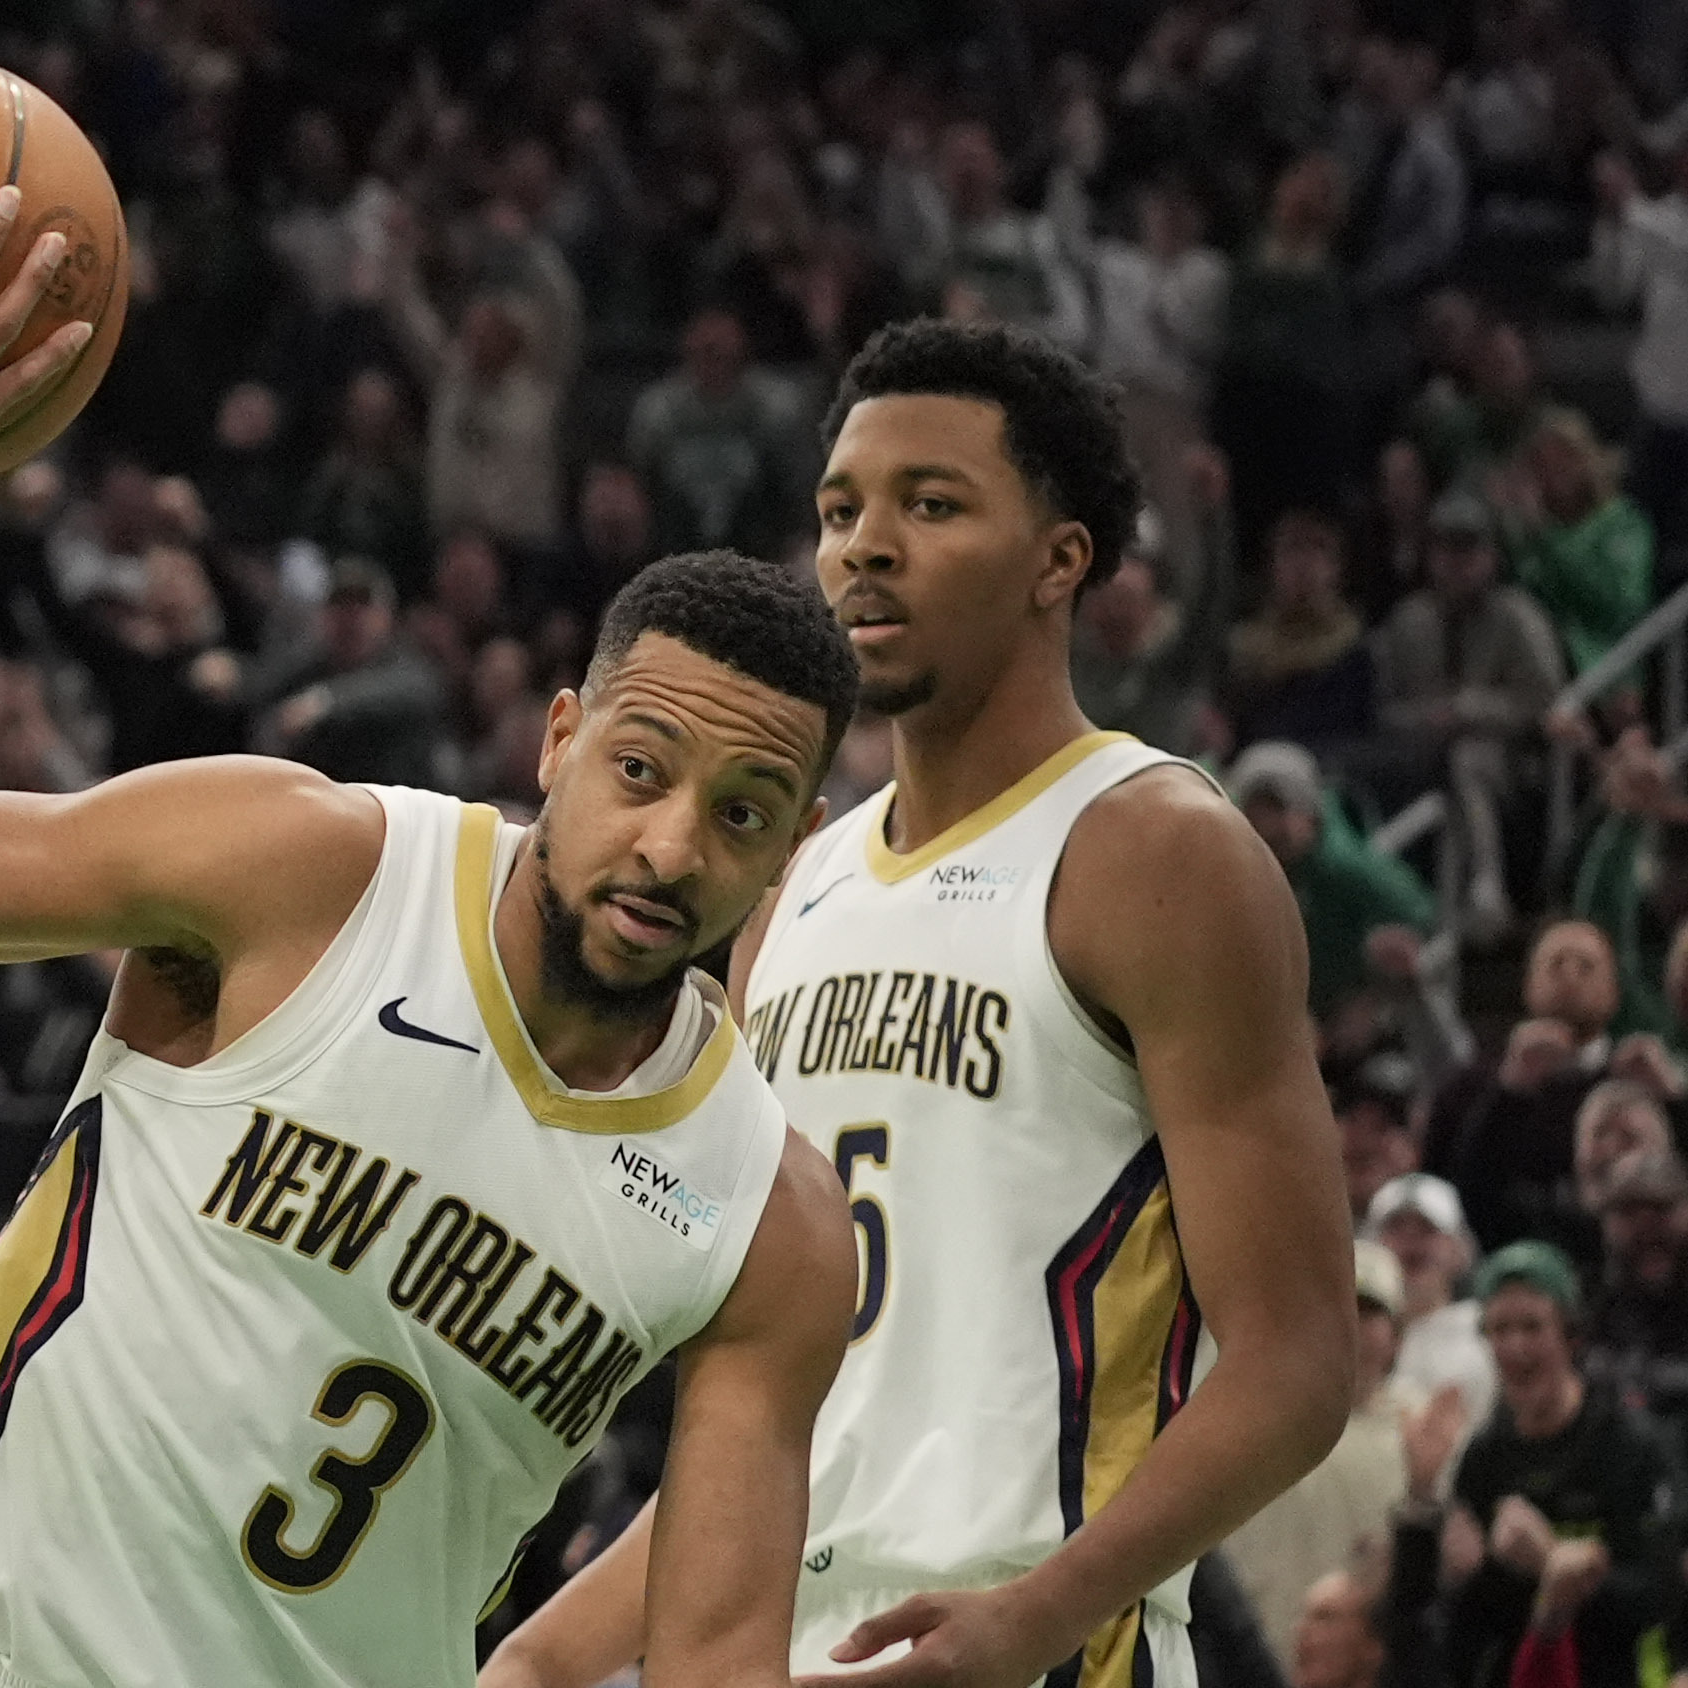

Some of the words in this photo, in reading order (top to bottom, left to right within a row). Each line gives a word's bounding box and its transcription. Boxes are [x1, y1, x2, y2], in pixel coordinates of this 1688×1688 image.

[796, 970, 1012, 1102] ORLEANS
[198, 1107, 423, 1276] NEW
[386, 1193, 644, 1450] ORLEANS
[620, 1182, 691, 1237] GRILLS
[238, 1355, 437, 1597] 3
